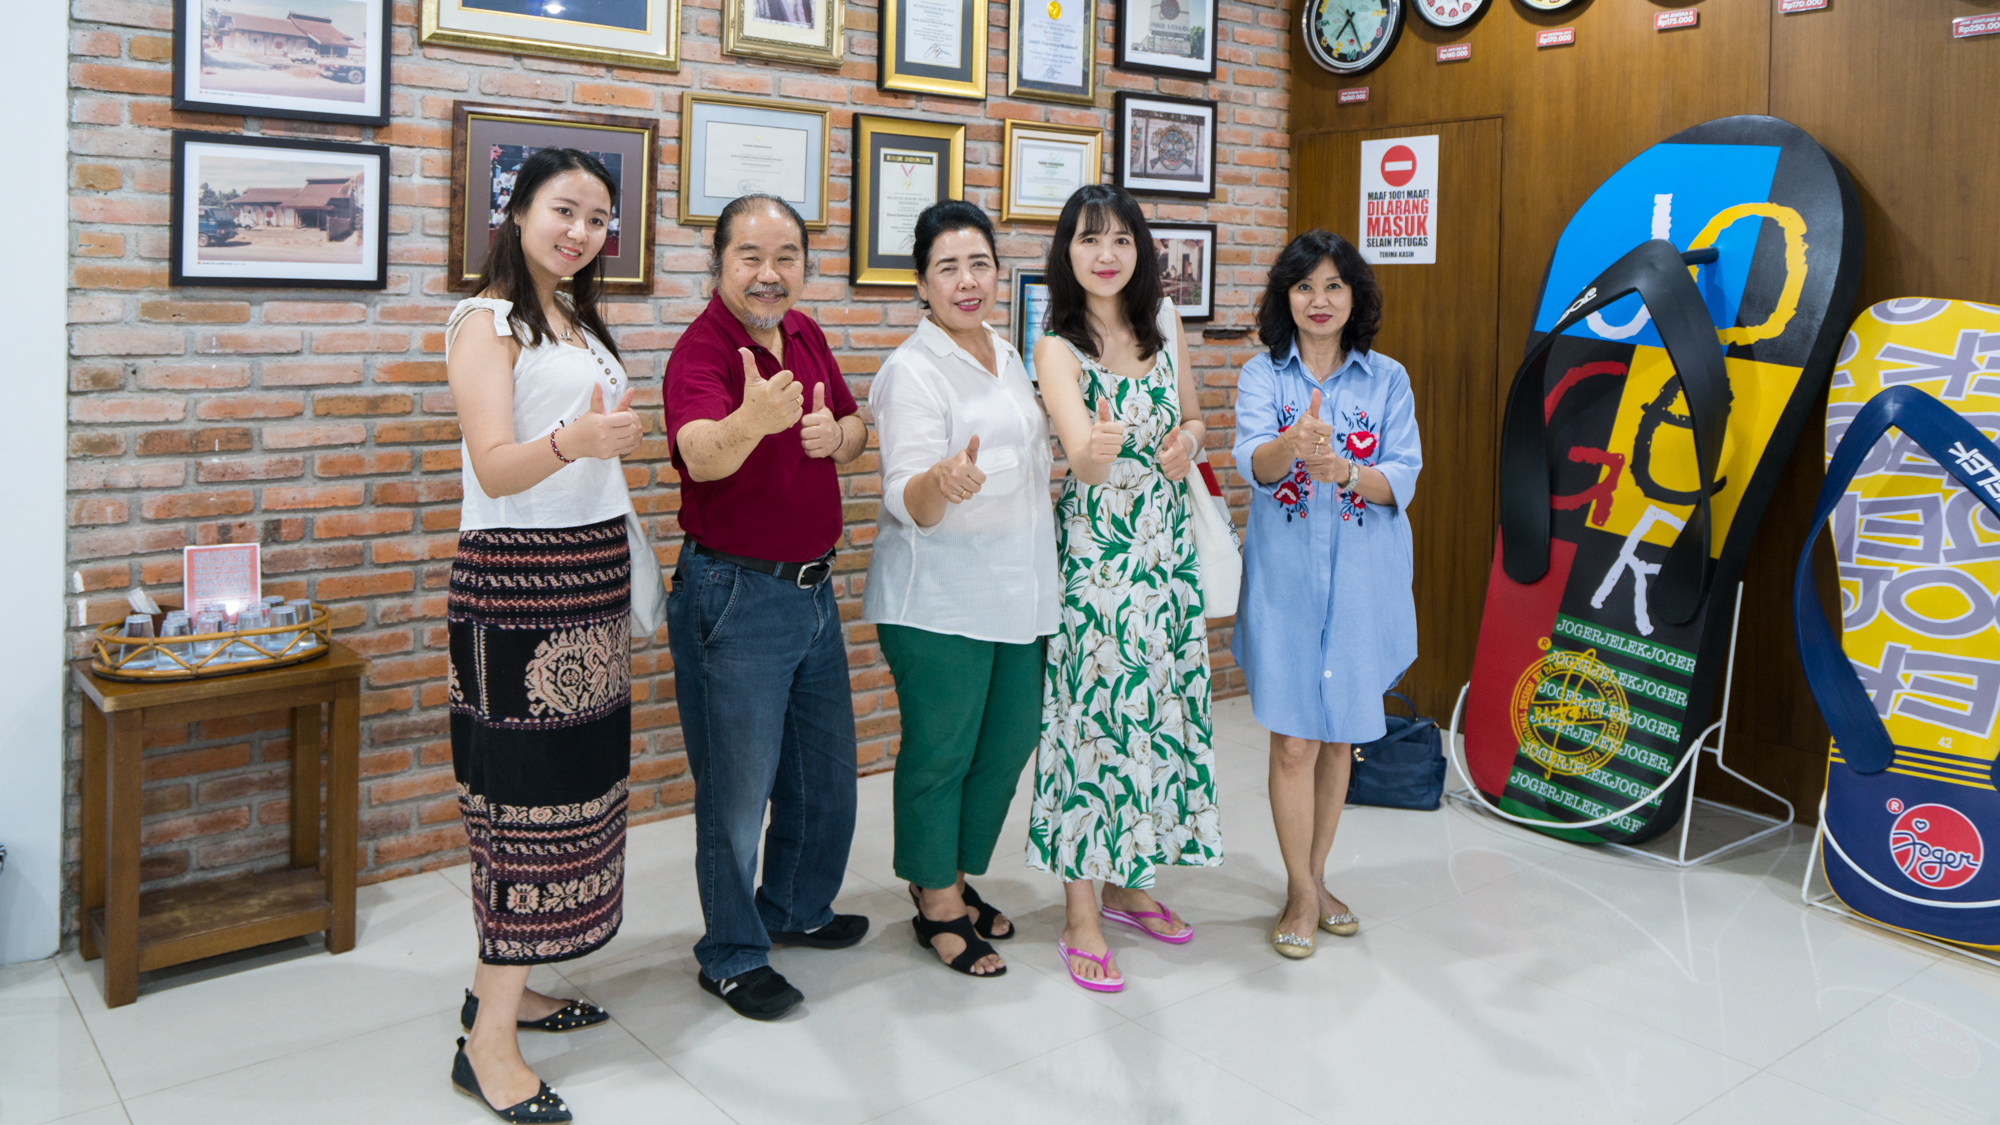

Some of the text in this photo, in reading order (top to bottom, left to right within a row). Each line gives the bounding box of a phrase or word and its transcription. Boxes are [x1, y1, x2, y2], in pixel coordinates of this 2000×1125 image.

[1782, 0, 1823, 11] Rp170.000
[1657, 15, 1694, 27] Rp175.000
[1958, 21, 2000, 35] Rp250.00
[1368, 190, 1429, 200] MAAF 1001 MAAF!
[1367, 199, 1429, 216] DILARANG
[1367, 215, 1428, 238] MASUK
[1366, 237, 1428, 248] SELAIN PETUGAS
[1556, 618, 1696, 673] JOGERJELEKJOGER
[1547, 650, 1688, 708] JOGERJELEKJOGER
[1937, 736, 1953, 749] 42
